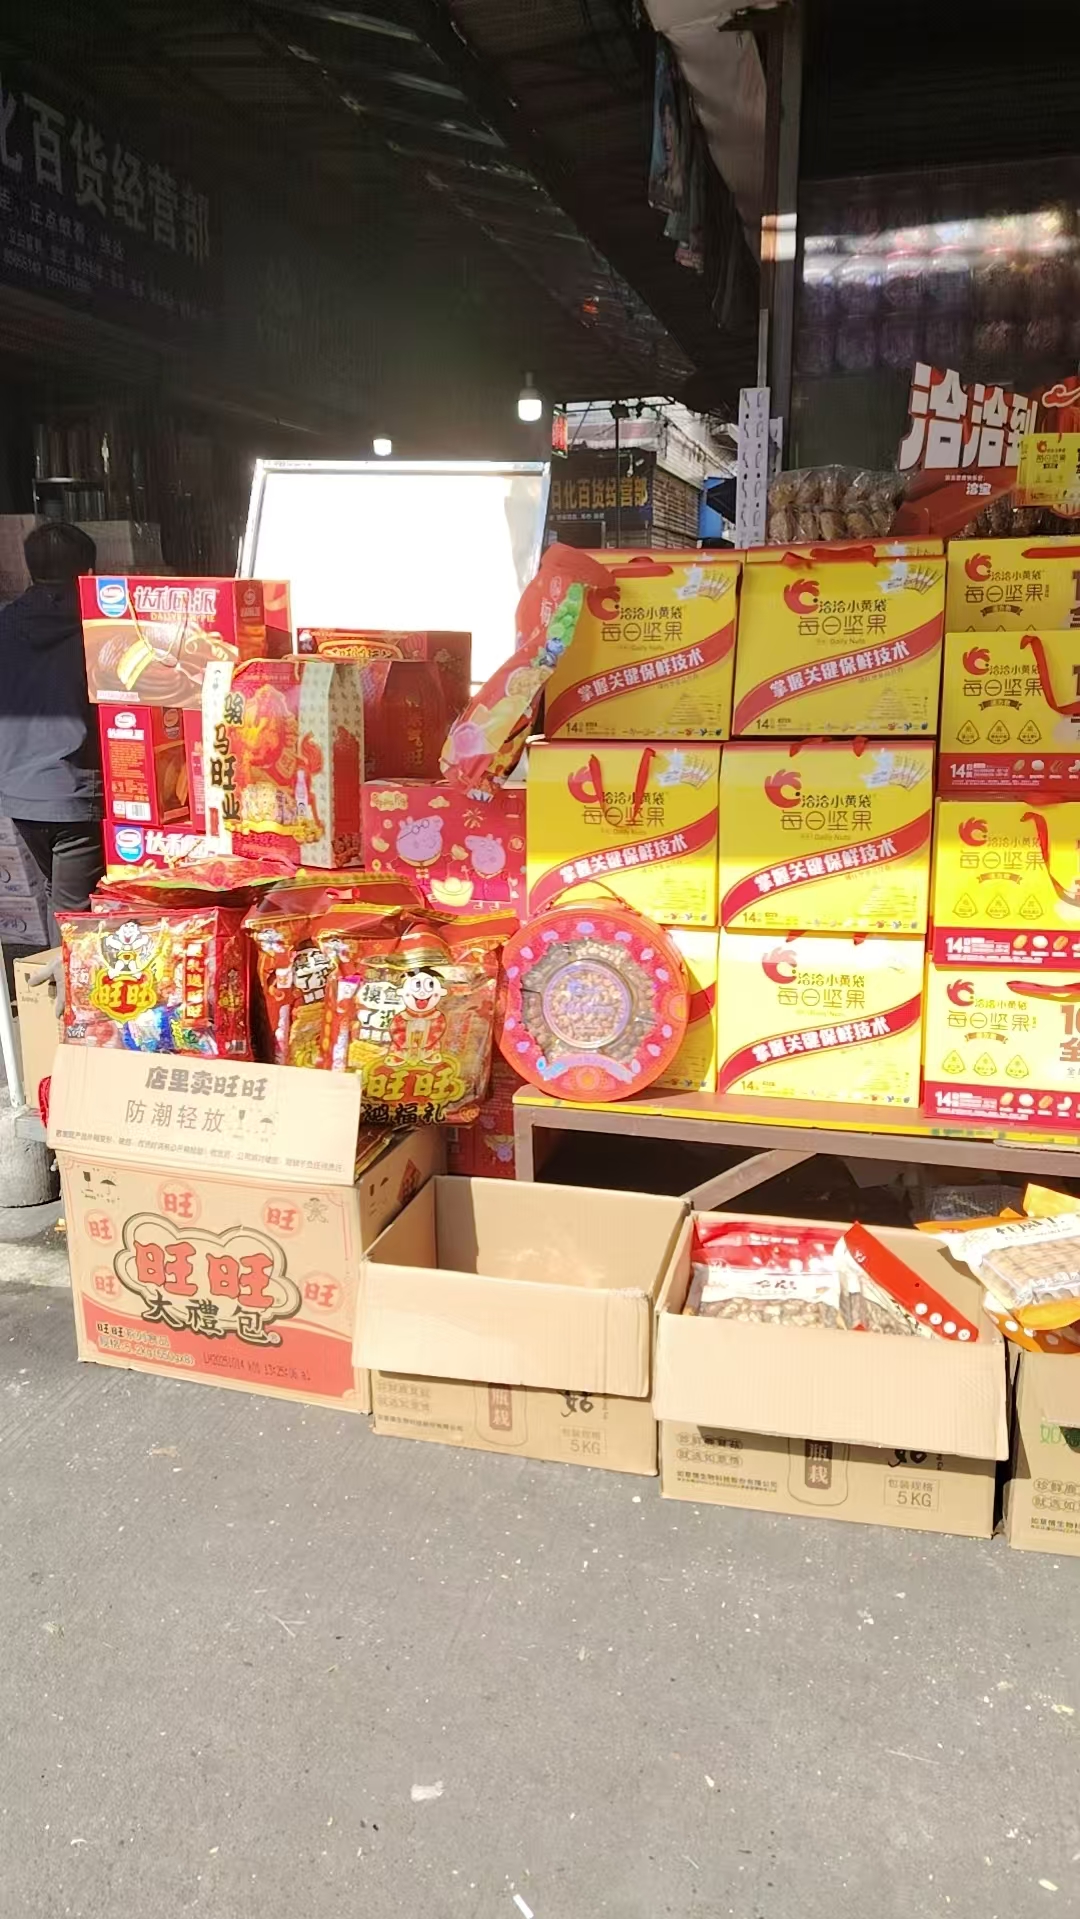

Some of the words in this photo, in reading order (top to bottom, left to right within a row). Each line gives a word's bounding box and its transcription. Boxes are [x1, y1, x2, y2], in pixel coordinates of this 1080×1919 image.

[552, 477, 648, 511] 日化百货经营部
[964, 583, 1043, 604] 每日坚果
[620, 606, 682, 620] 洽洽小黄袋
[818, 599, 887, 613] 洽洽小黄袋
[601, 622, 683, 642] 每日坚果
[797, 614, 887, 636] 每日坚果
[577, 648, 704, 703] 掌握关键保鲜技术
[769, 641, 911, 699] 掌握关键保鲜技术
[962, 678, 1043, 697] 每日坚果
[801, 794, 872, 808] 洽洽小黄袋
[581, 806, 665, 828] 每日坚果
[780, 810, 872, 831] 每日坚果
[560, 833, 688, 884] 掌握关键保鲜技术
[753, 837, 898, 893] 掌握关键保鲜技术
[959, 850, 1046, 871] 每日坚果
[797, 973, 865, 988] 洽洽小黄袋
[98, 980, 150, 1009] 旺旺
[362, 984, 401, 1006] 摸鱼
[776, 986, 866, 1009] 每日坚果
[947, 1010, 1030, 1032] 每日坚果
[752, 1015, 891, 1063] 掌握关键保鲜技术
[145, 1066, 269, 1101] 店里卖旺旺
[367, 1066, 454, 1102] 旺旺
[124, 1099, 226, 1134] 防潮轻放
[163, 1191, 194, 1219] 旺
[88, 1217, 113, 1241] 旺
[267, 1207, 297, 1232] 旺
[95, 1273, 117, 1295] 旺
[133, 1239, 275, 1309] 旺旺
[304, 1282, 338, 1308] 旺
[142, 1290, 281, 1347] 大禮包
